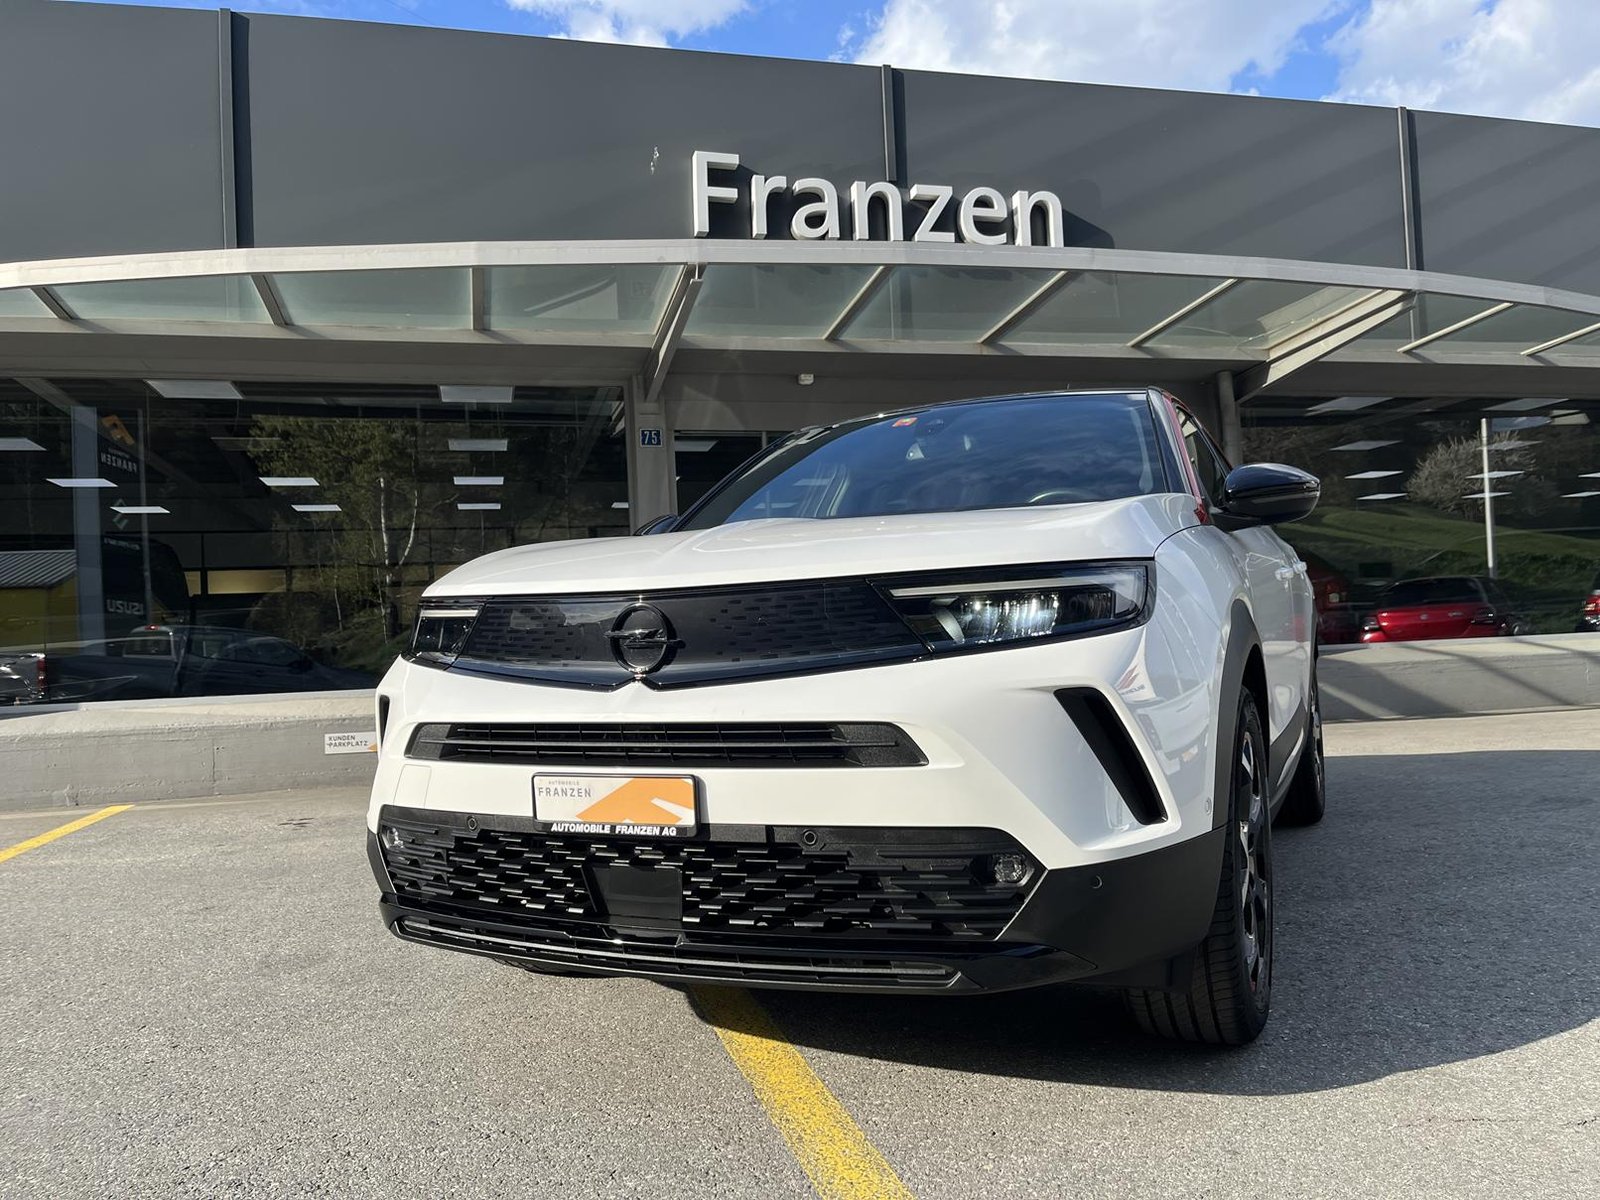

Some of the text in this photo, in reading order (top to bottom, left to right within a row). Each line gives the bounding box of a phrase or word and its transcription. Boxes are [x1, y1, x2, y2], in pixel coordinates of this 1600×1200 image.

[692, 150, 1065, 248] Franzen
[644, 431, 658, 445] 75
[538, 787, 592, 798] FRANZEN
[551, 823, 677, 837] AUTOMOBILE FRANZEN AG
